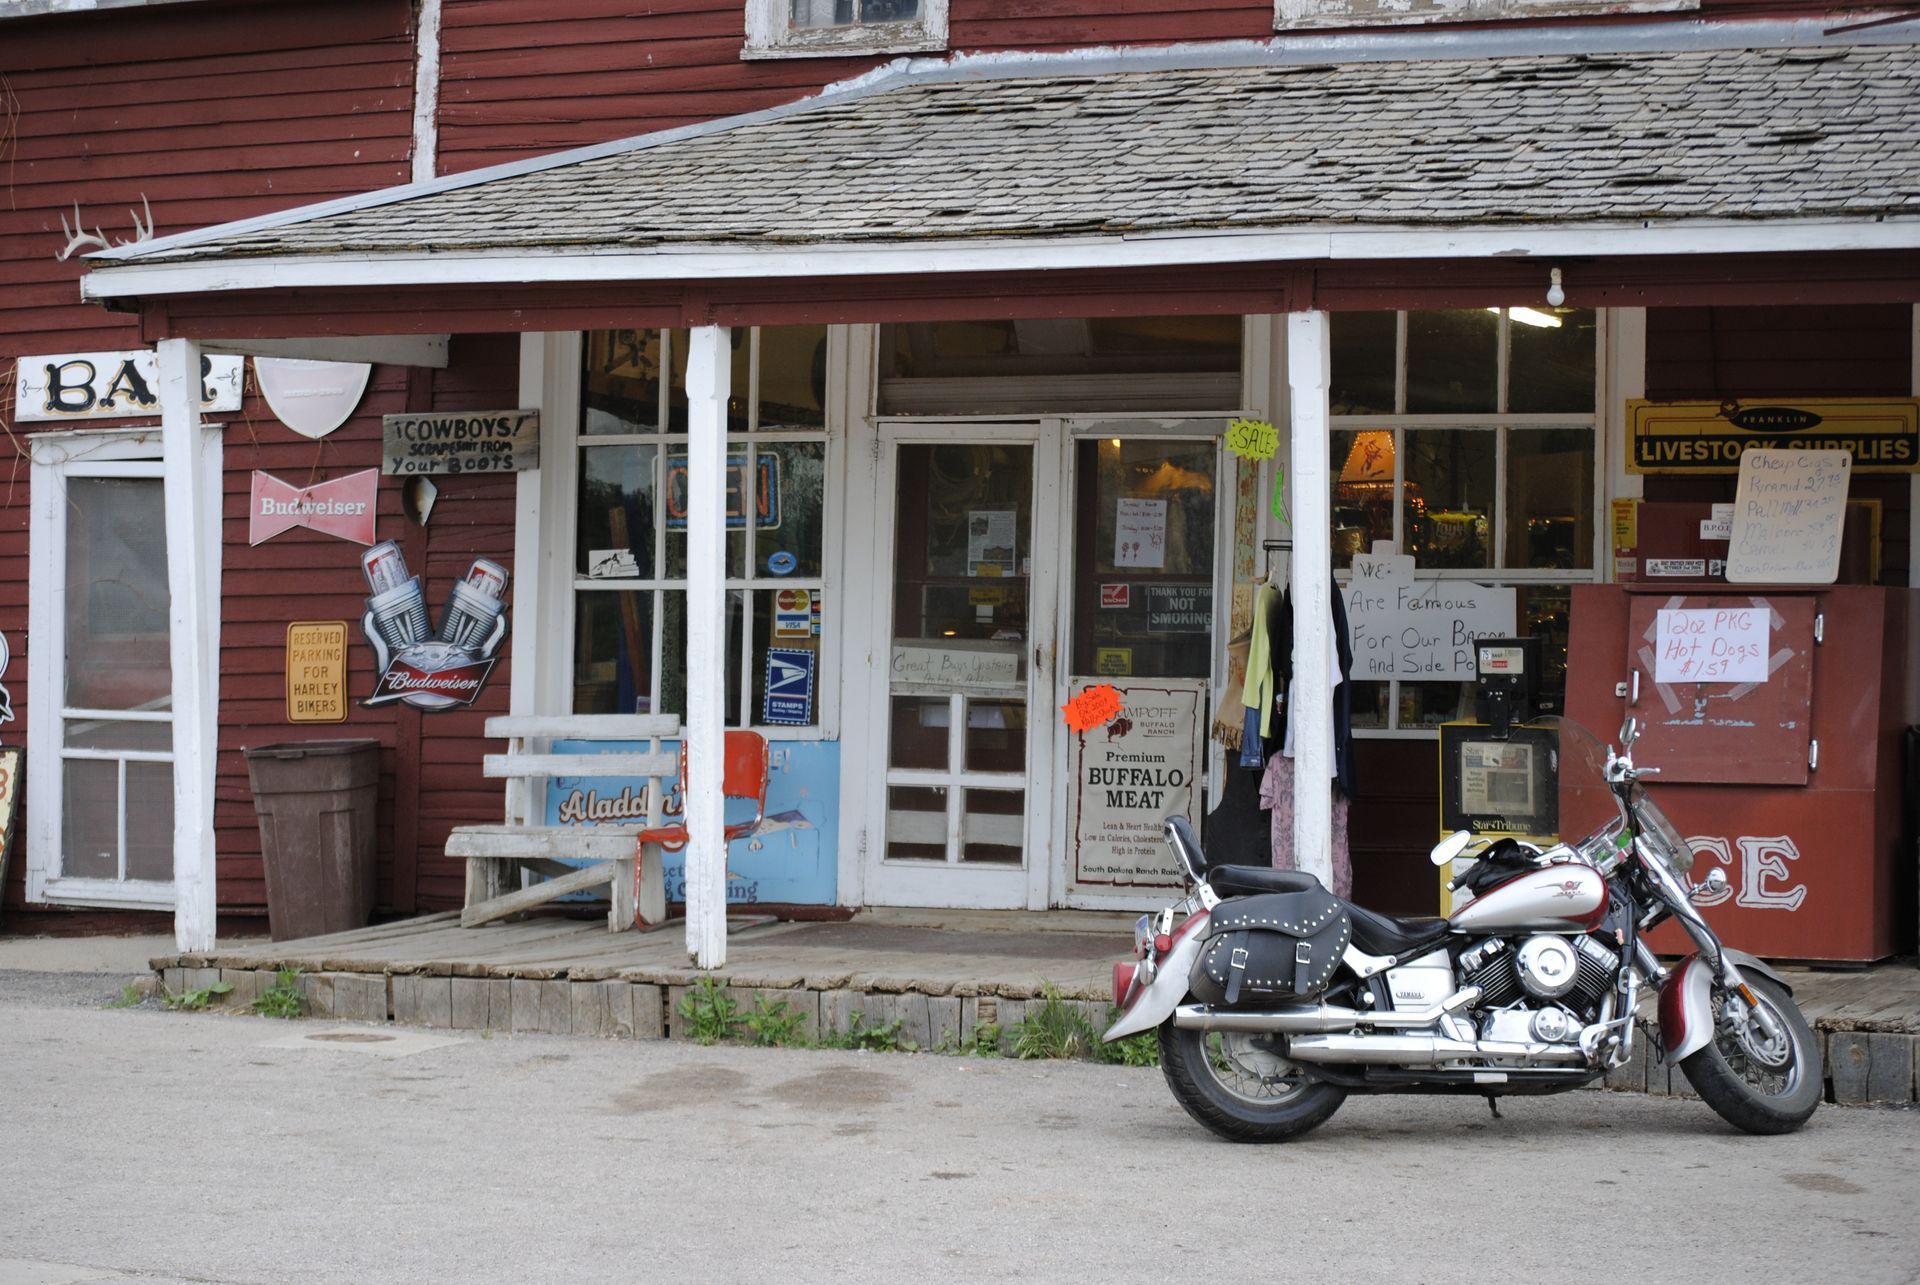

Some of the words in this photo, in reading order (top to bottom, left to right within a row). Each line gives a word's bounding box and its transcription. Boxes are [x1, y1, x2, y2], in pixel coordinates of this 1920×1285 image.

[1743, 414, 1808, 424] FRANKLIN
[1235, 426, 1271, 455] SALE
[1751, 456, 1795, 474] Cheap
[667, 464, 770, 518] OEN
[260, 497, 366, 516] Budweiser
[1151, 587, 1178, 597] THANK
[1180, 587, 1197, 597] YOU
[1169, 597, 1196, 610] NOT
[1350, 590, 1385, 613] Are
[1397, 586, 1477, 611] Famous
[1151, 613, 1213, 625] SMOKING
[1667, 611, 1705, 635] 12oz
[1714, 610, 1752, 631] PKG
[294, 631, 341, 645] RESERVED
[1353, 624, 1393, 651] For
[1401, 627, 1441, 649] Our
[292, 648, 341, 662] PARKING
[1665, 637, 1702, 660] Hot
[1711, 636, 1760, 664] Dogs
[1402, 652, 1445, 673] Side
[1678, 657, 1729, 679] $1.59
[303, 665, 329, 679] FOR
[386, 671, 479, 690] Budweiser
[294, 683, 338, 696] HARLEY
[297, 700, 337, 713] BIKERS
[772, 701, 804, 710] STAMPS
[1140, 721, 1176, 729] BUFFALO
[1106, 752, 1166, 764] Premium
[1088, 767, 1184, 788] BUFFALO
[559, 784, 685, 824] Aladdn'
[1106, 790, 1165, 810] MEAT
[1103, 822, 1118, 831] Lean
[1472, 819, 1491, 831] Star
[1084, 833, 1098, 842] Low
[1099, 833, 1106, 842] in
[1133, 834, 1165, 844] Cholestero
[1111, 846, 1126, 856] High
[1127, 847, 1133, 855] in
[1134, 847, 1156, 856] Protein
[1083, 865, 1104, 874] South
[1107, 866, 1133, 875] Dakota
[1135, 867, 1159, 876] Ranch
[1683, 835, 1807, 912] CE
[1400, 991, 1423, 999] YAMAHA
